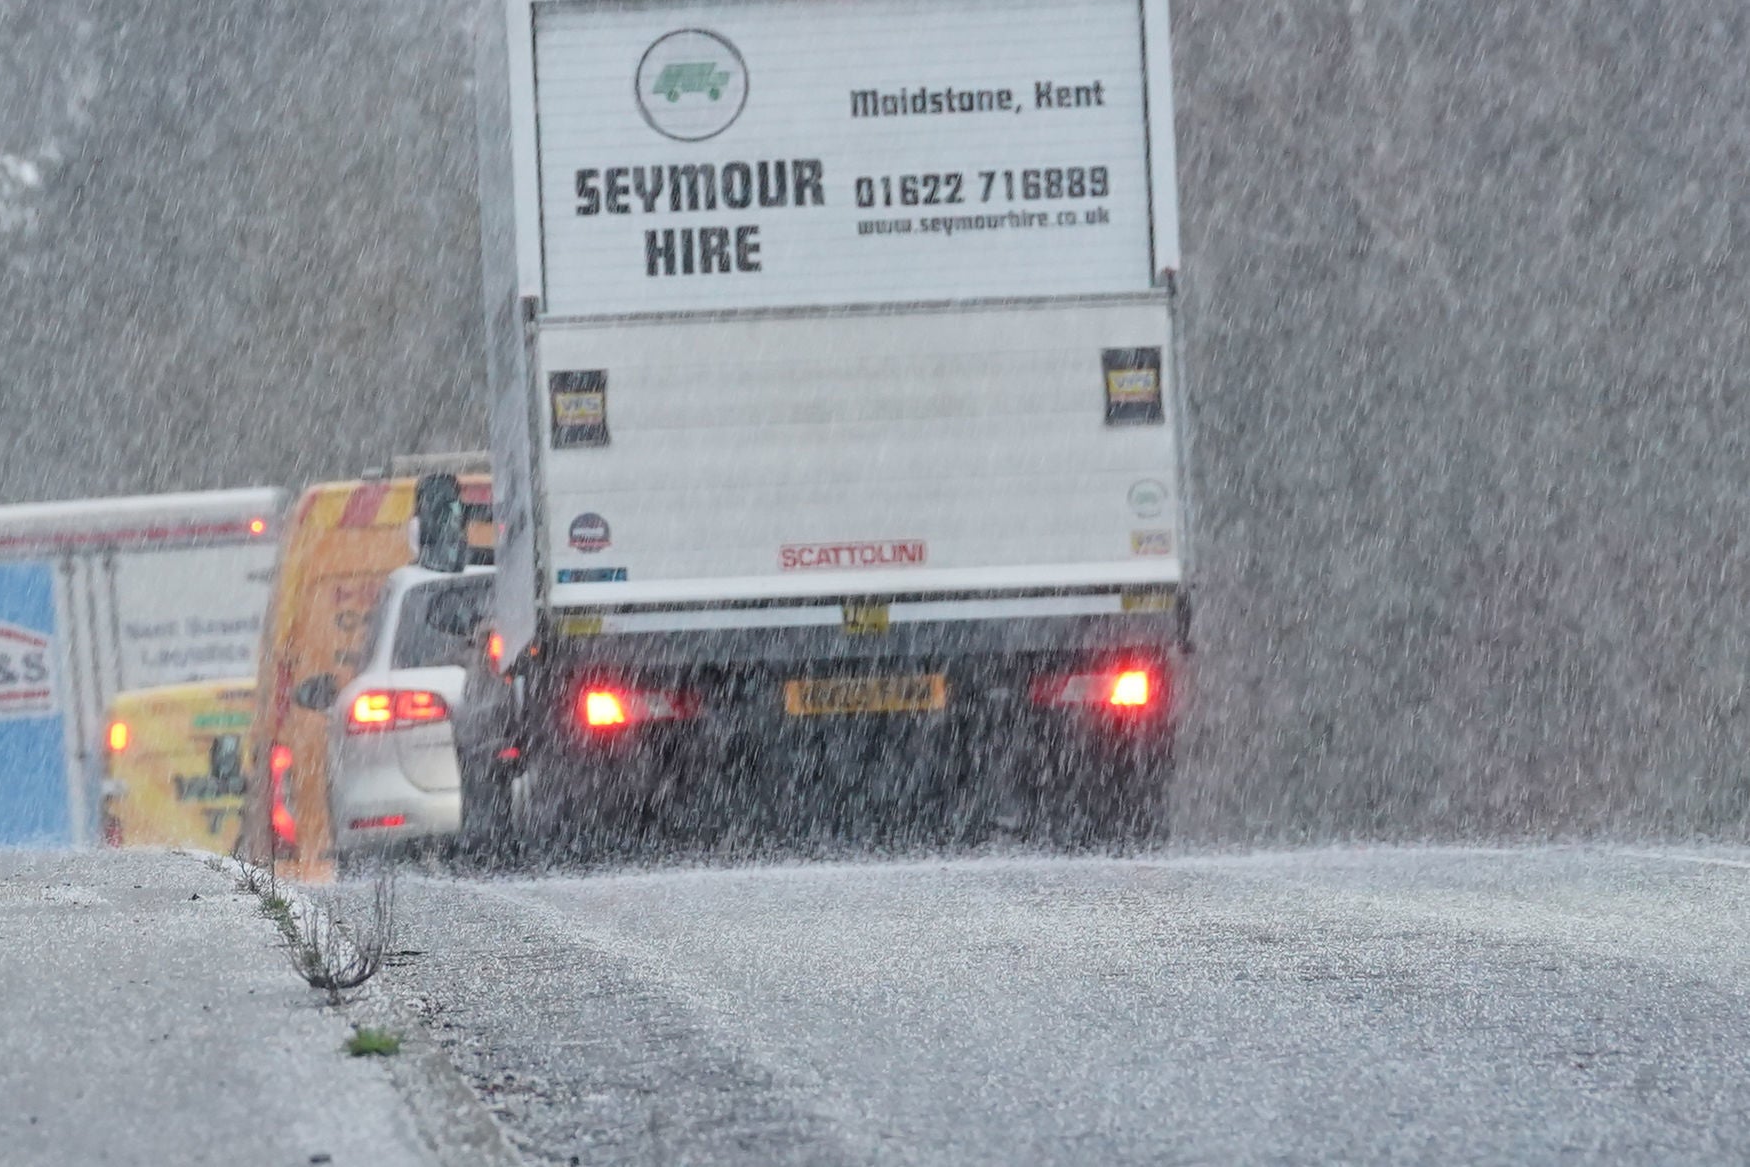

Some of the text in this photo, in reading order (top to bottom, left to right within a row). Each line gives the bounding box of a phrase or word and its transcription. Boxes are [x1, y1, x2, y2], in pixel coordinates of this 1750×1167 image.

[850, 80, 1106, 118] Maidstone, Kent
[575, 158, 825, 216] SEYMOUR
[855, 166, 1109, 208] 01622 716889
[644, 225, 762, 276] HIRE
[781, 543, 924, 568] SCATTOLINI
